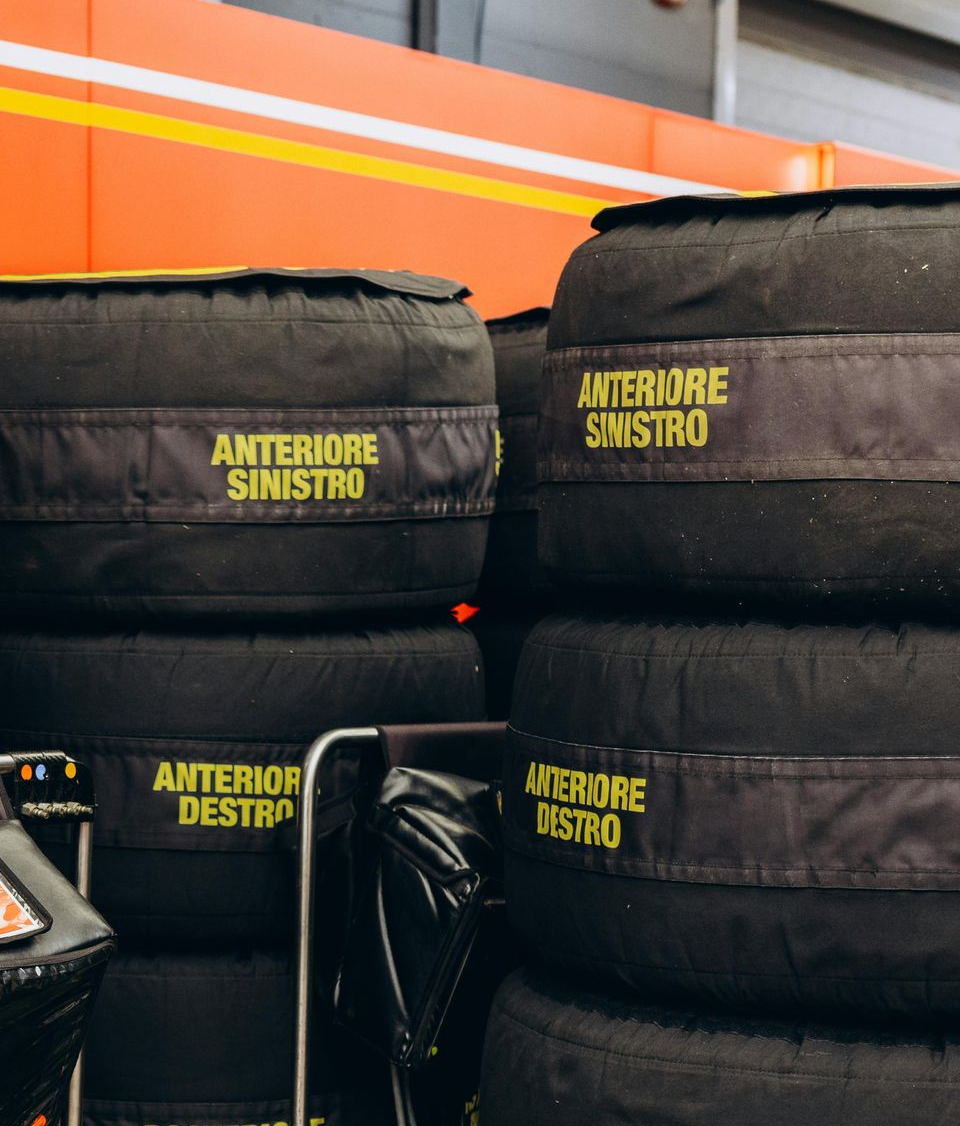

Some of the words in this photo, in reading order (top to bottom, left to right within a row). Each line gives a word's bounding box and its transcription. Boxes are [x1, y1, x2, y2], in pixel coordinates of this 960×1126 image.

[577, 367, 729, 408] ANTERIORE
[586, 408, 708, 449] SINISTRO
[210, 433, 379, 466] ANTERIORE
[227, 467, 365, 500] SINISTRO
[152, 762, 321, 795] ANTERIOR
[525, 762, 647, 813] ANTERIORE
[537, 801, 621, 849] DESTRO
